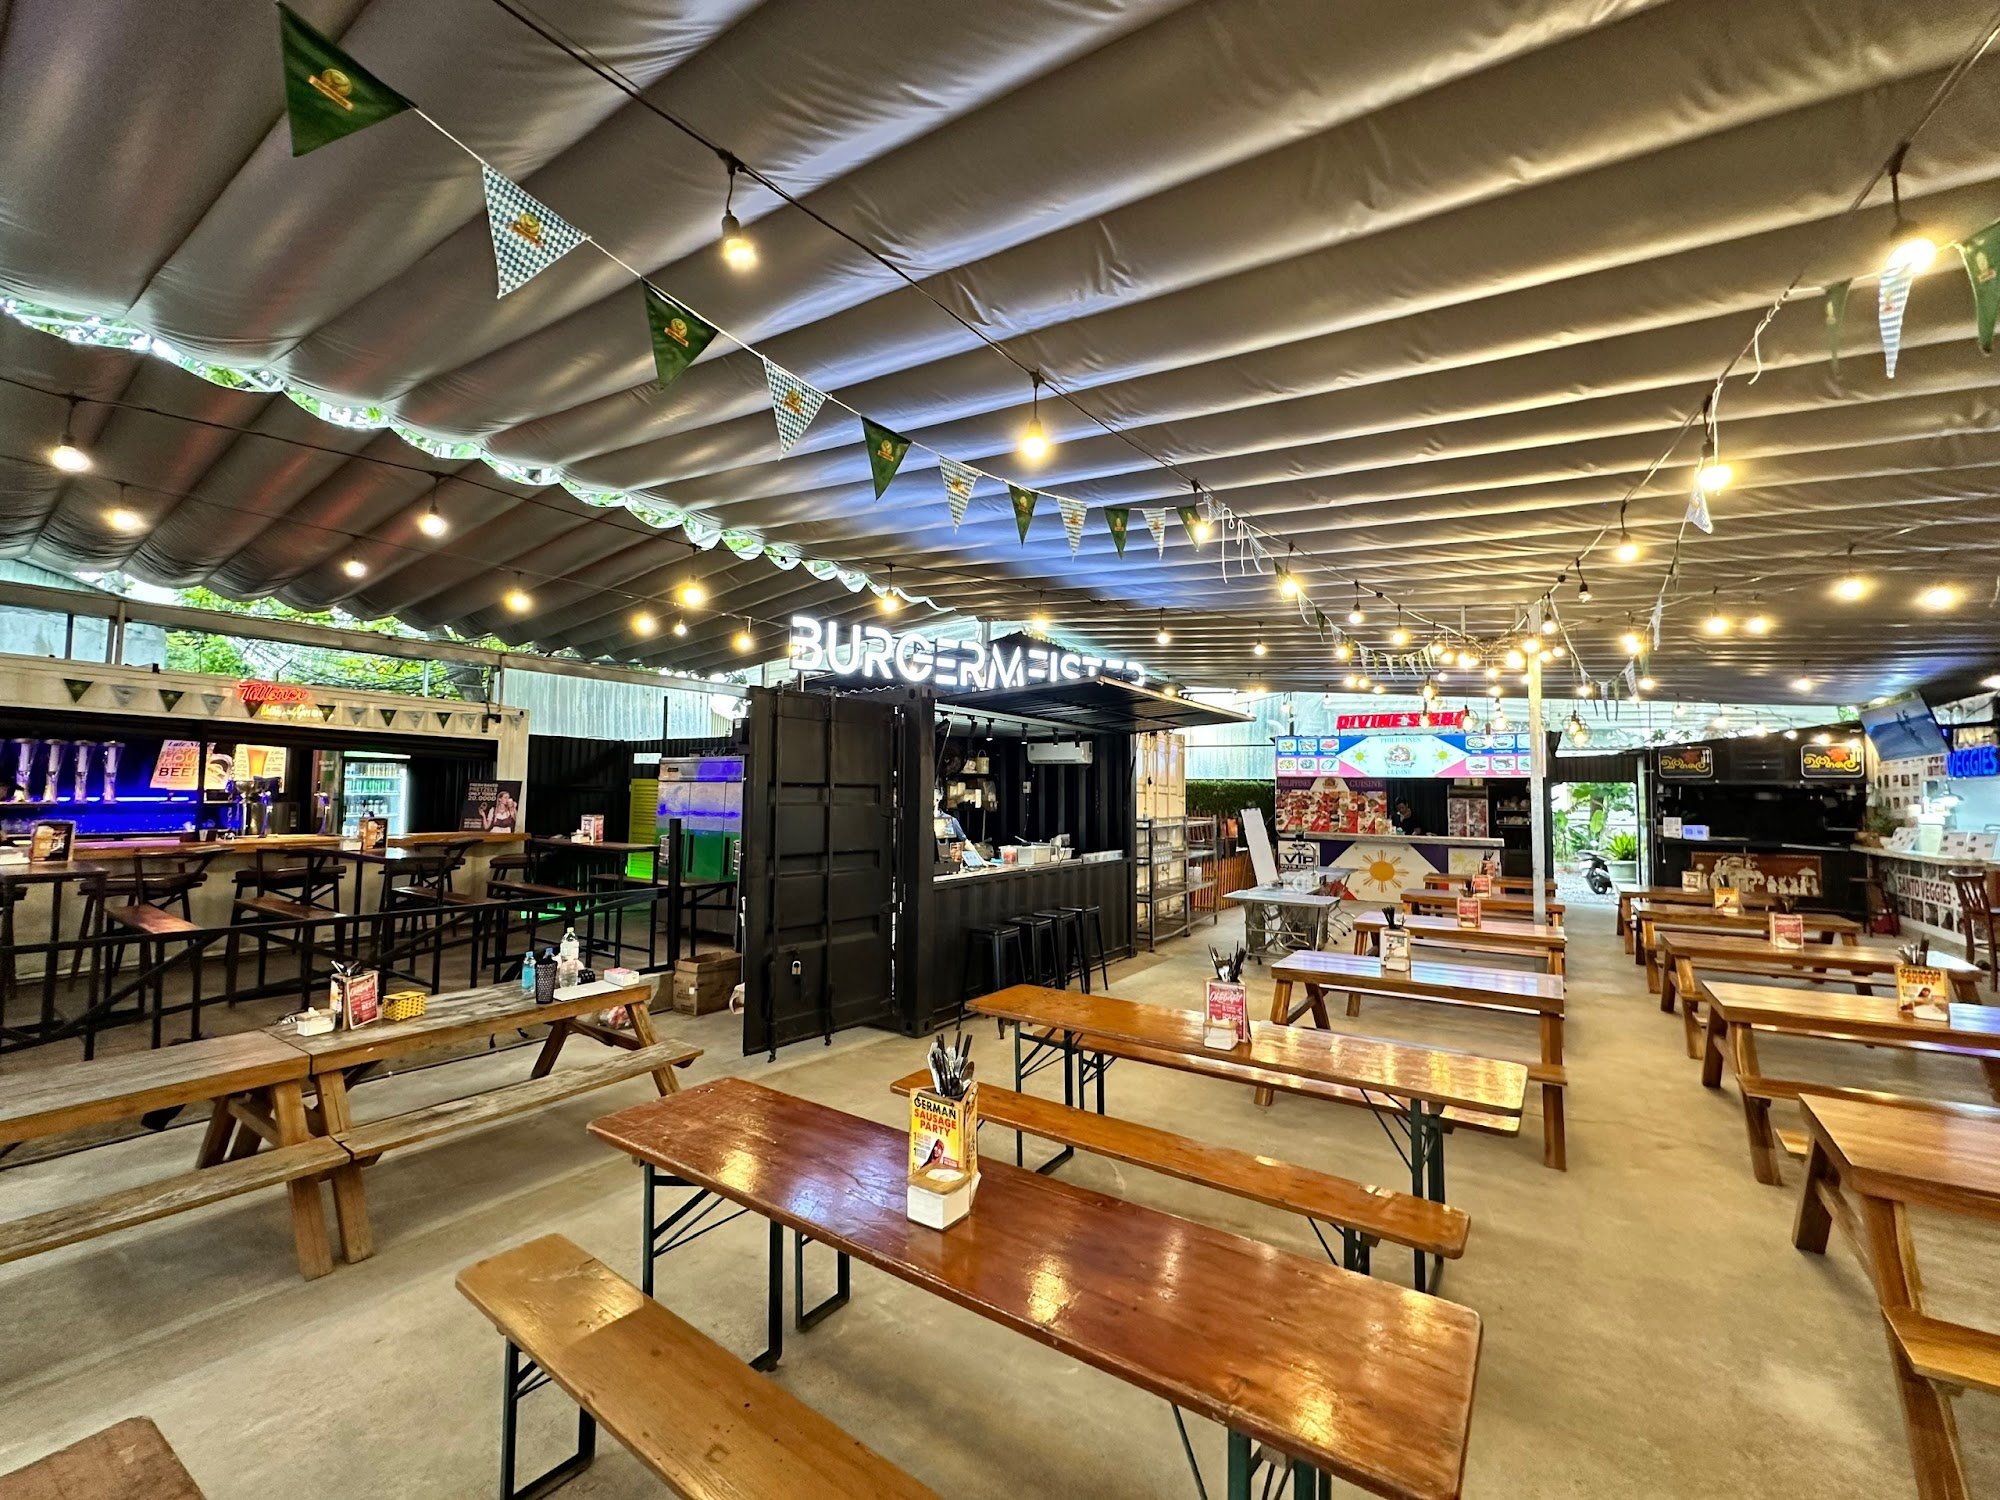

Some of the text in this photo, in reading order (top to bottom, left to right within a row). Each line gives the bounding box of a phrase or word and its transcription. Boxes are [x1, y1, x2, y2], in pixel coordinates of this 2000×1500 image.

[159, 767, 196, 777] BEE
[1947, 747, 1997, 777] VEGGIES
[1898, 876, 1920, 897] SANTO
[1921, 880, 1951, 905] VEGGIES
[914, 1096, 956, 1120] GERMAN
[914, 1108, 957, 1130] SAUSAGE
[920, 1120, 951, 1137] PARTY
